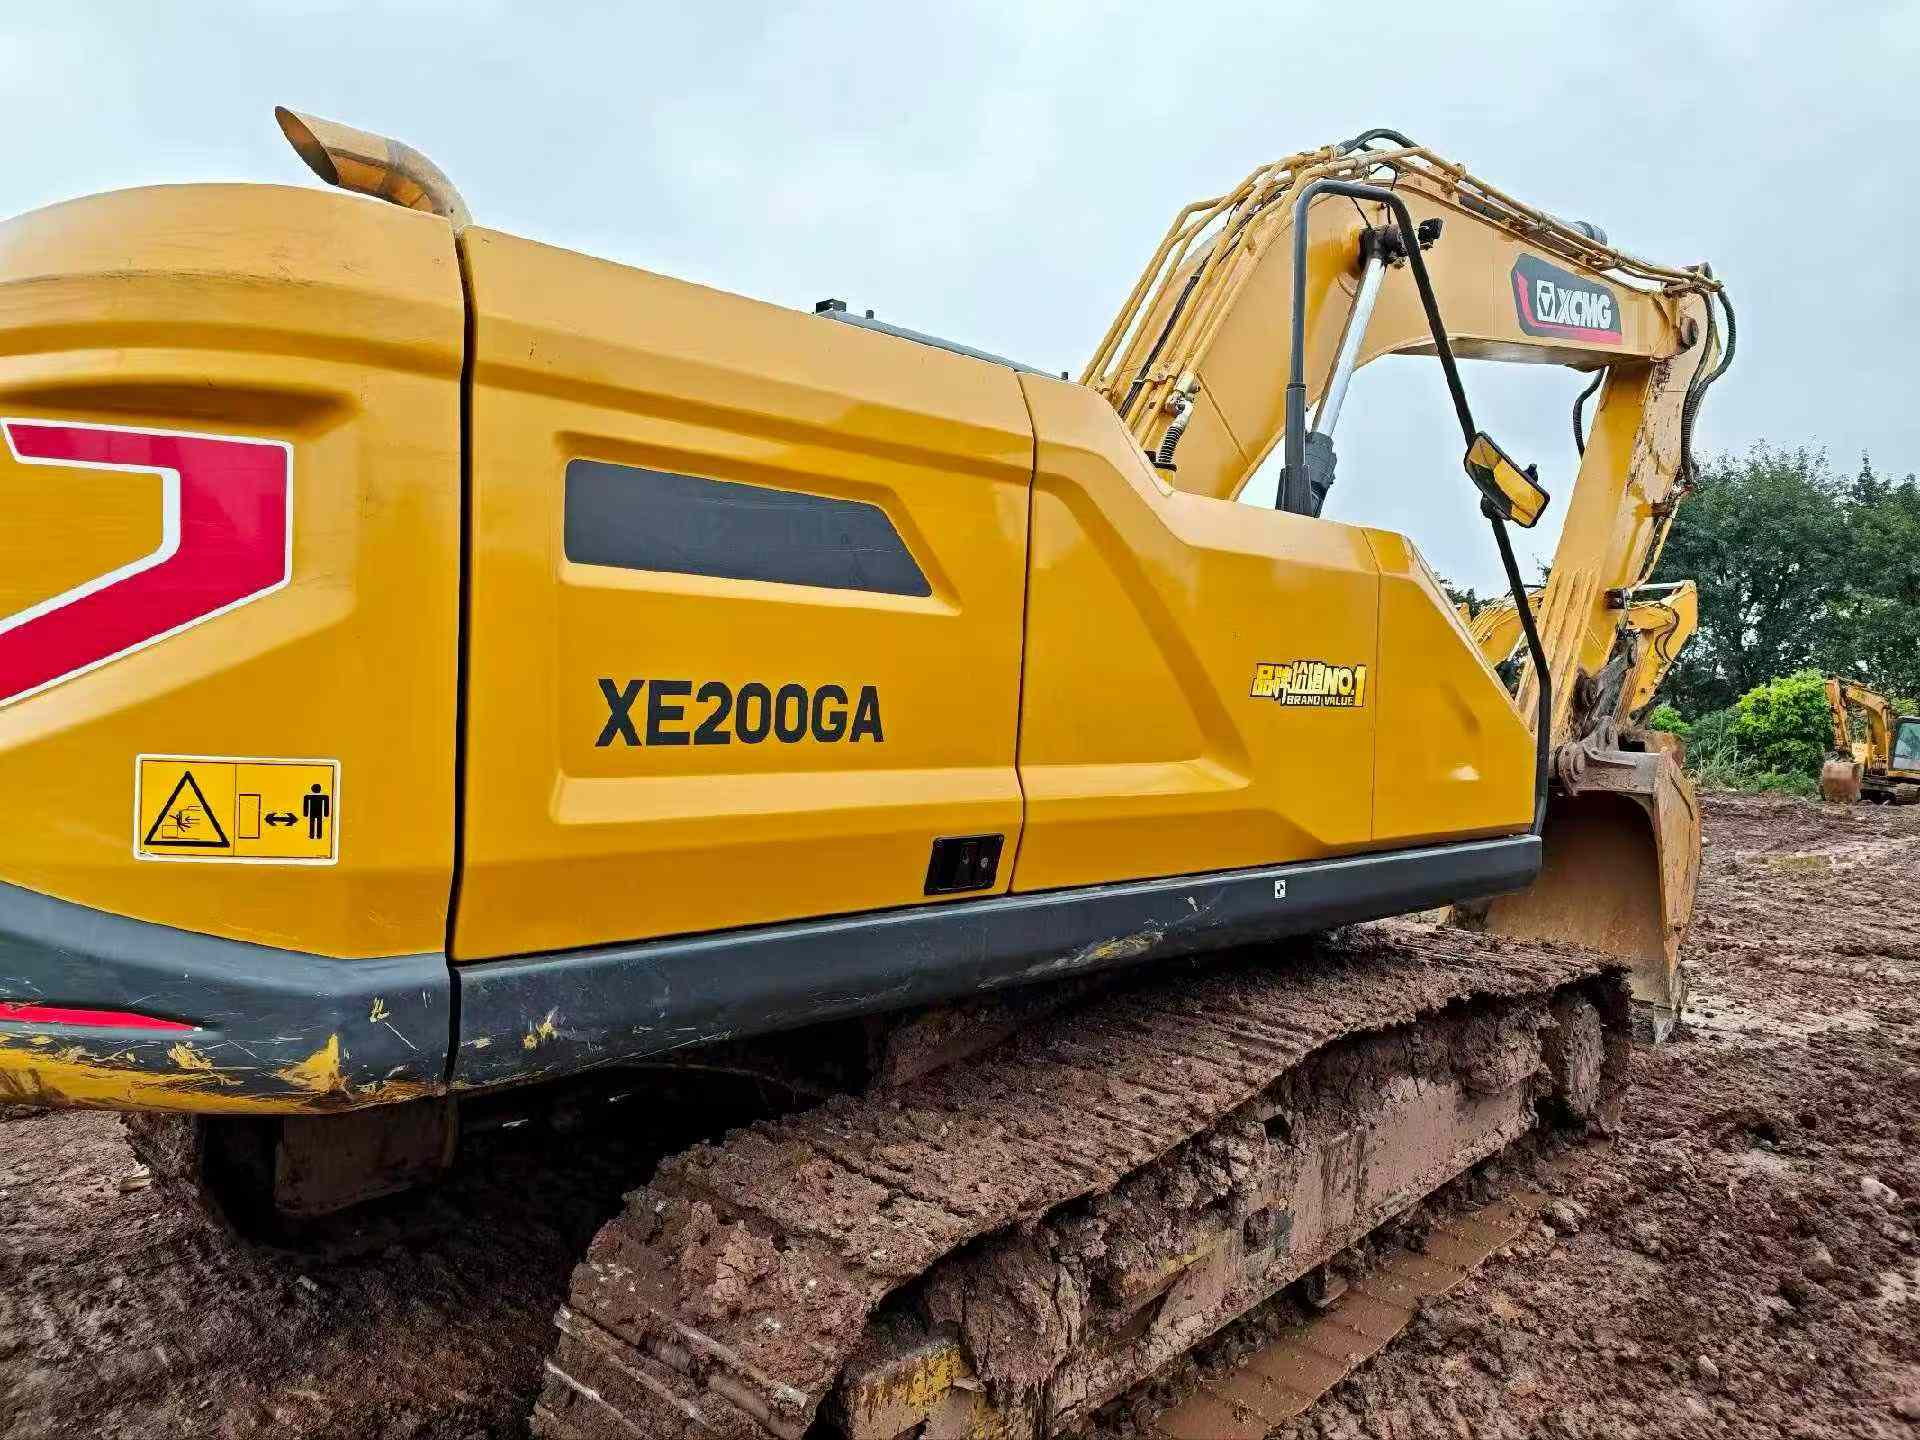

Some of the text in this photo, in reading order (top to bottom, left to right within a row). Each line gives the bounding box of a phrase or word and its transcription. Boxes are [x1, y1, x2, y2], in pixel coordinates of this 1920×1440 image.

[1556, 287, 1612, 329] XCMG
[595, 678, 884, 747] XE200GA
[1287, 695, 1354, 706] BRAND VALUE
